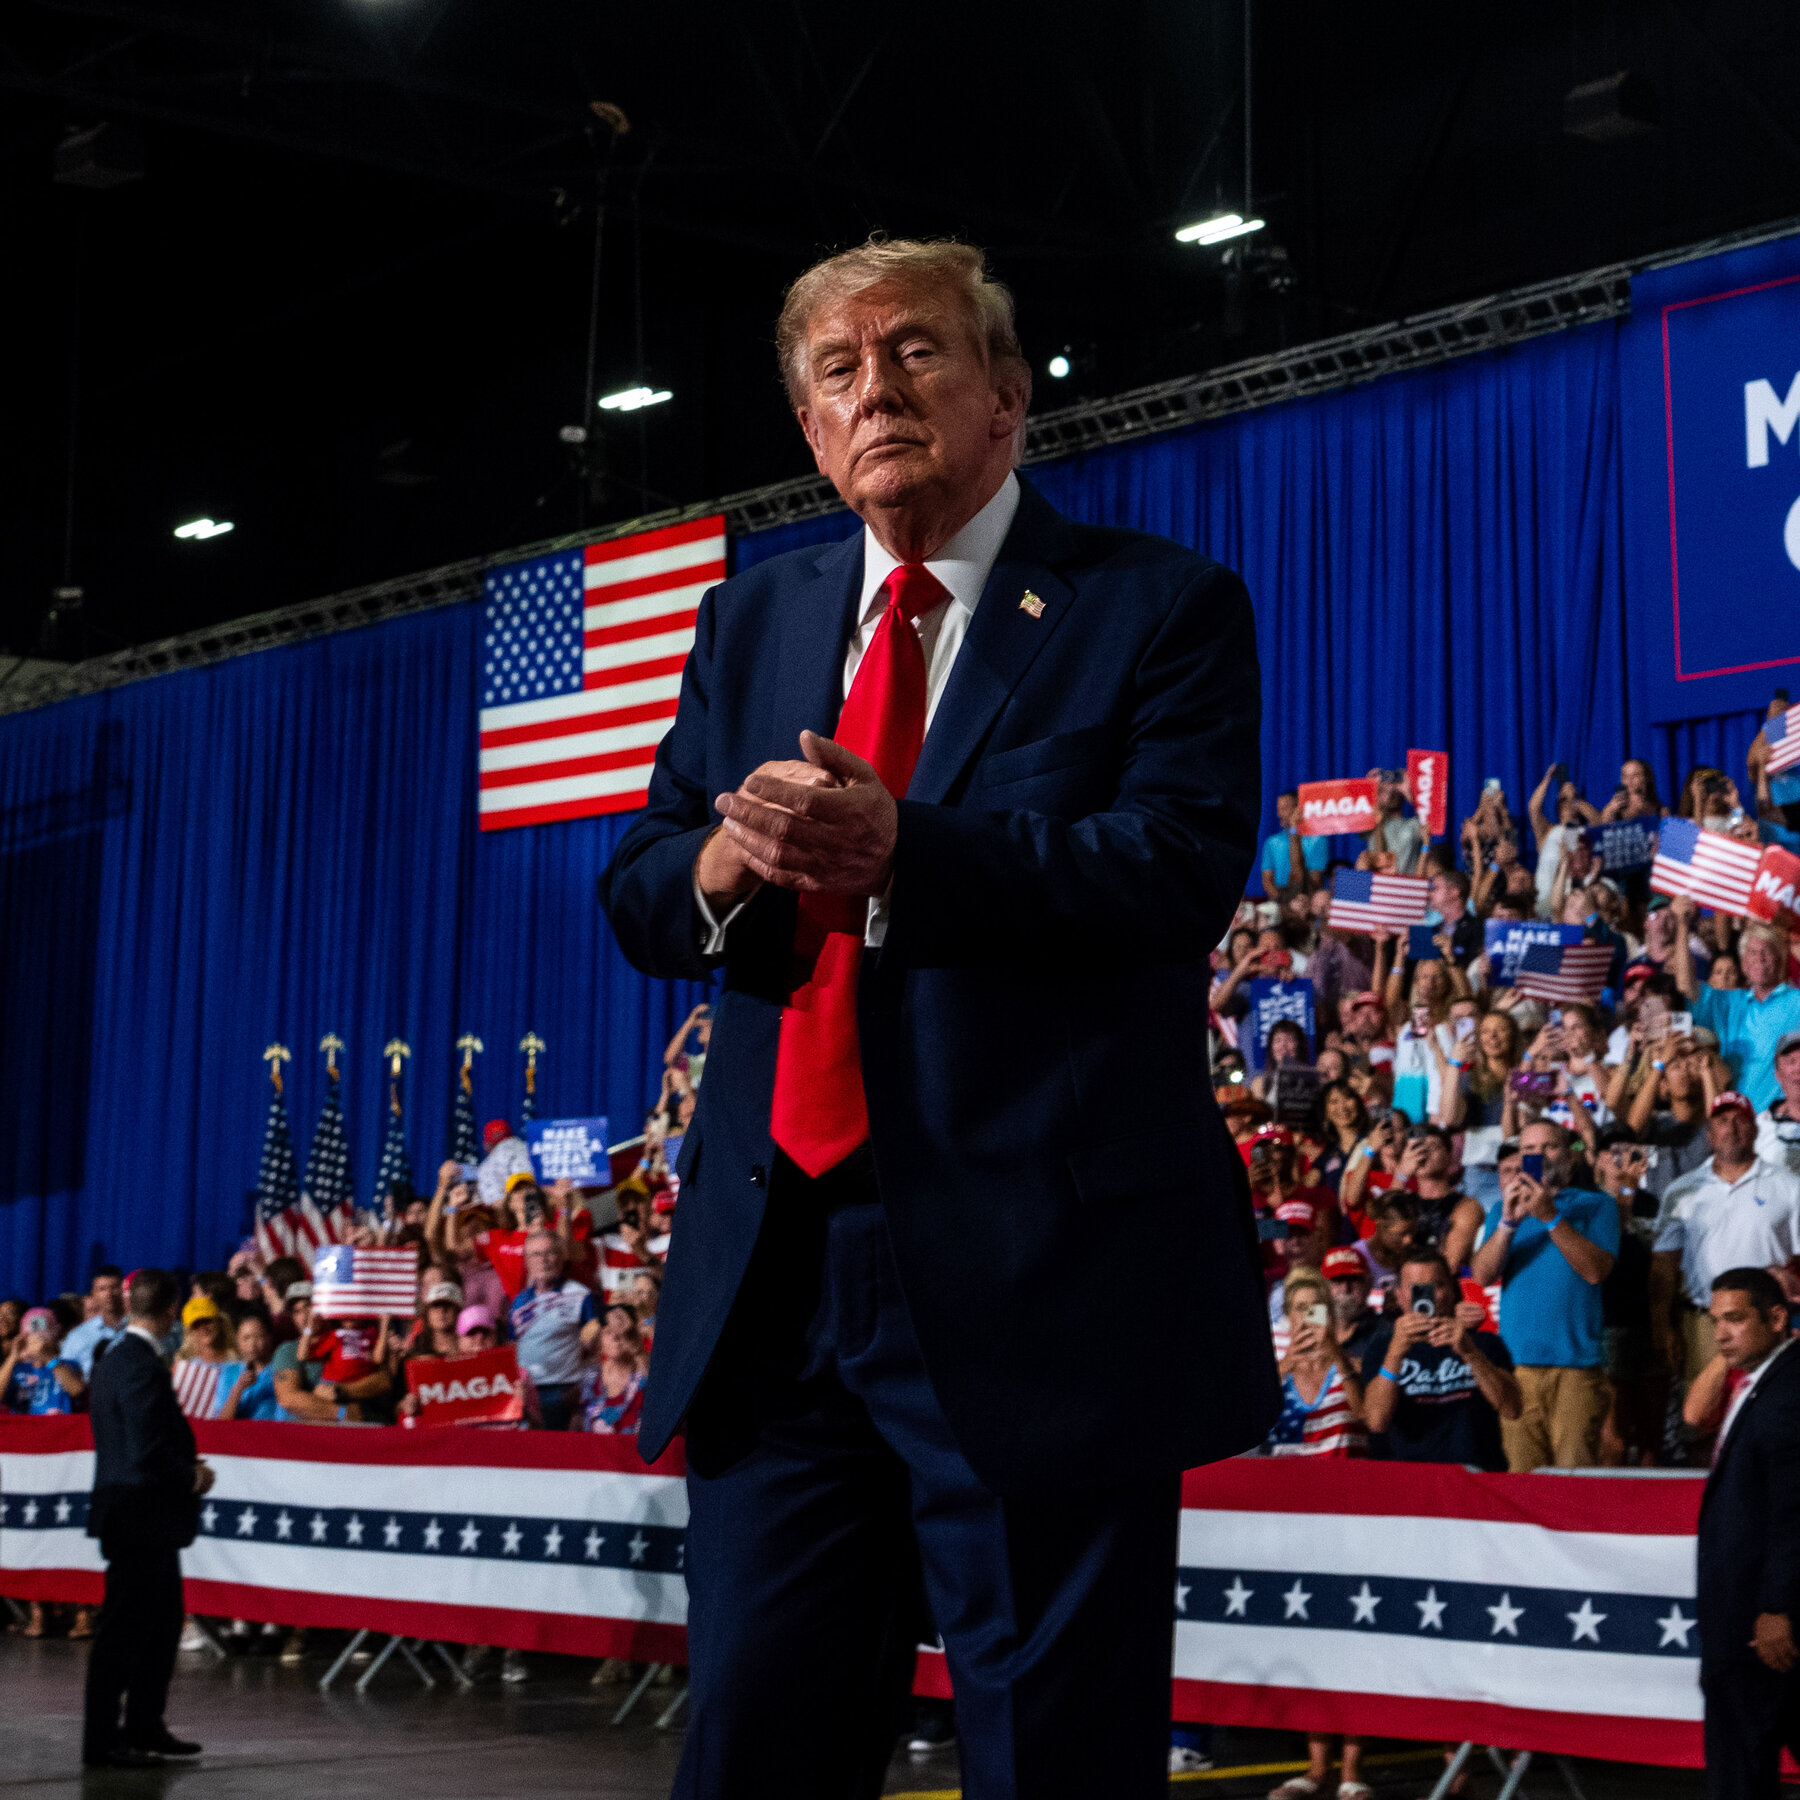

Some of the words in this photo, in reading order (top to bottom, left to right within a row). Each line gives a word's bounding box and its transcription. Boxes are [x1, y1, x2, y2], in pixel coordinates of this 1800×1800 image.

[1417, 757, 1434, 825] MAGA
[1303, 795, 1372, 818] MAGA
[1507, 929, 1561, 946] MAKE
[419, 1373, 513, 1405] MAGA
